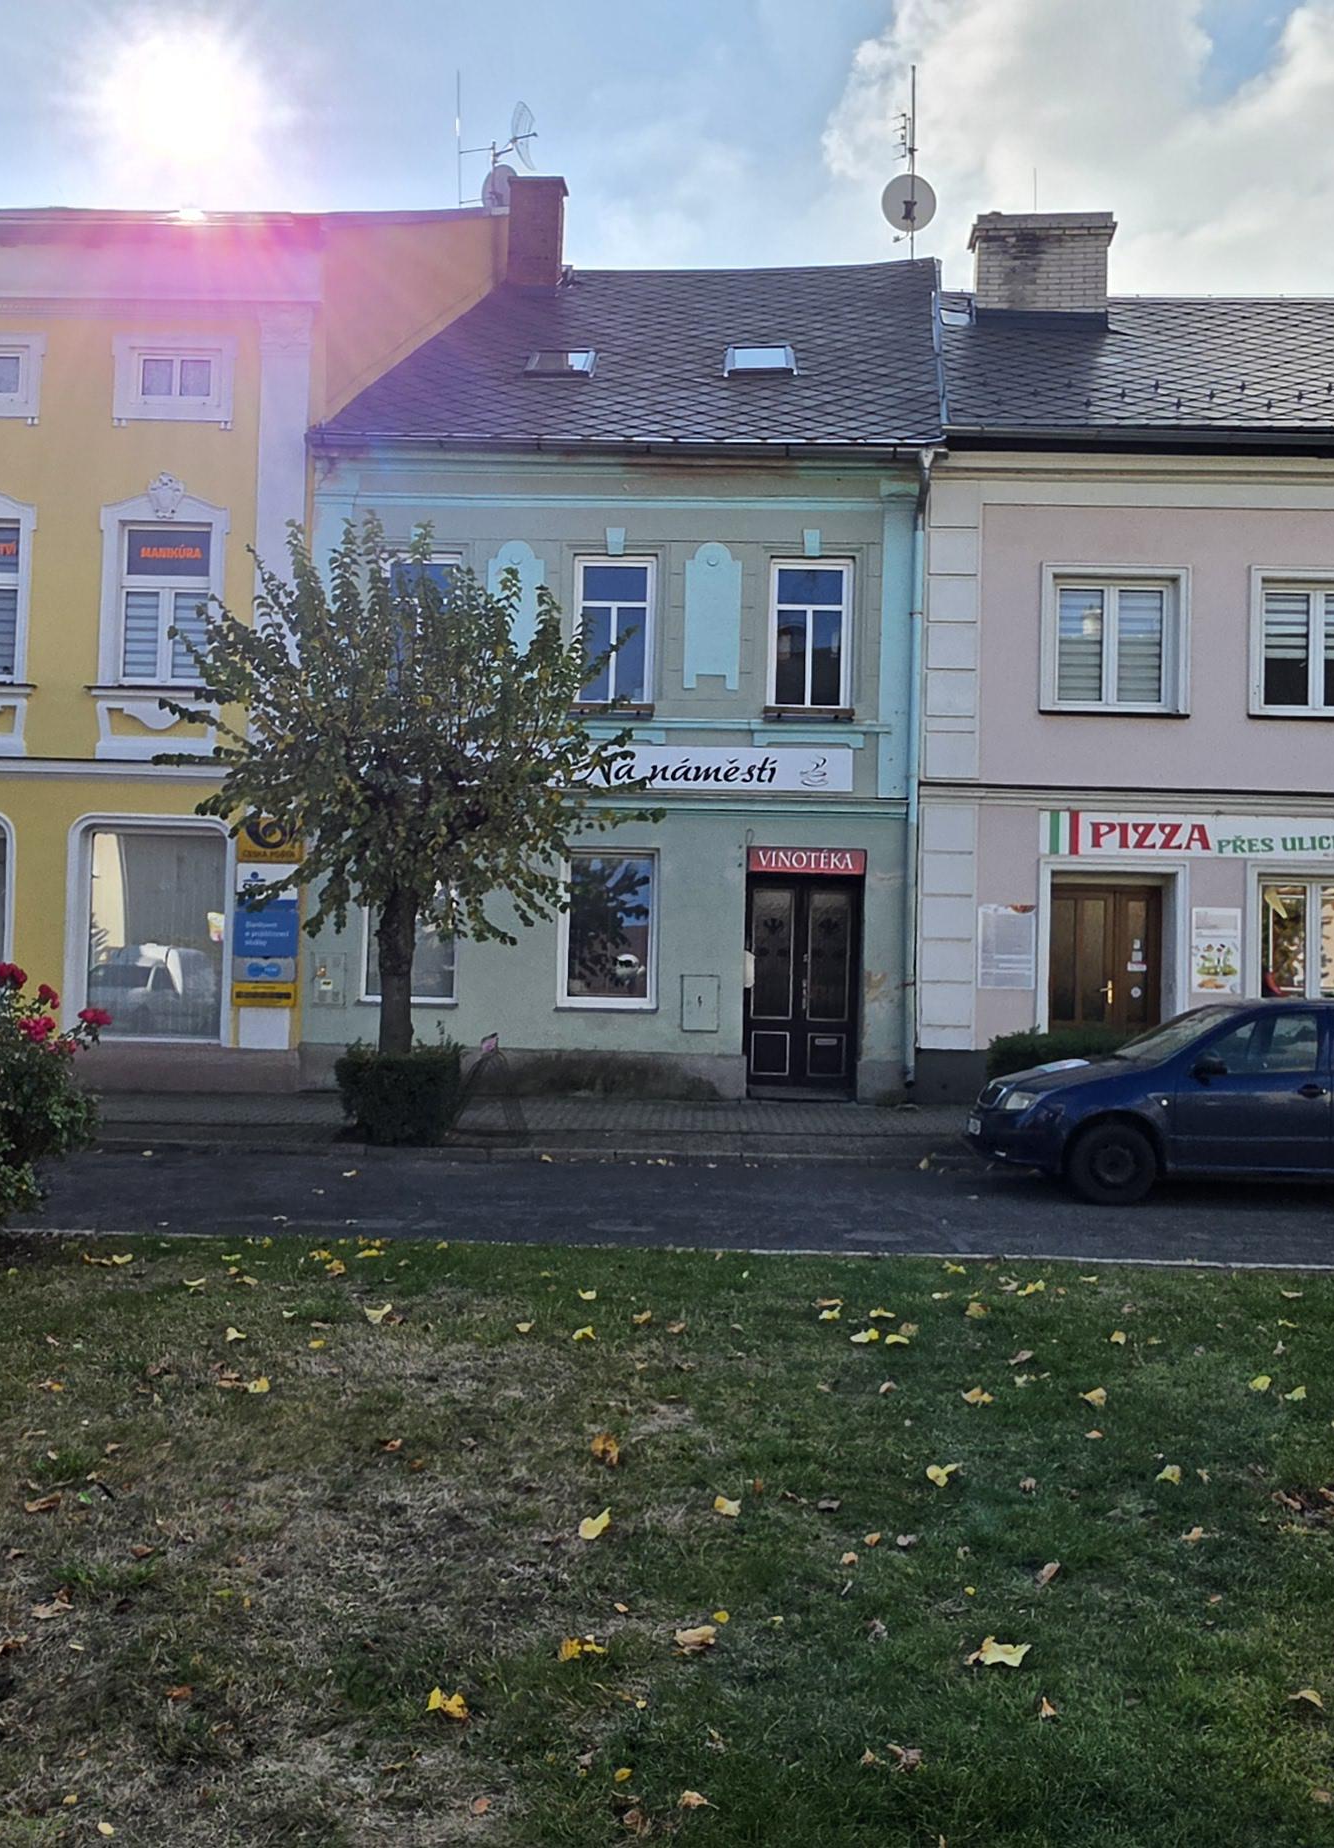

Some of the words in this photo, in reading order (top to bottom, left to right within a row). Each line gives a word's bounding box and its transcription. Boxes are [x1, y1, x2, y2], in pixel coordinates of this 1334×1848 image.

[140, 544, 202, 559] MANIKÚRA
[649, 756, 777, 783] náměstí
[1090, 822, 1212, 851] PIZZA
[1217, 836, 1275, 854] PŘES
[759, 849, 853, 869] VINOTÉKA
